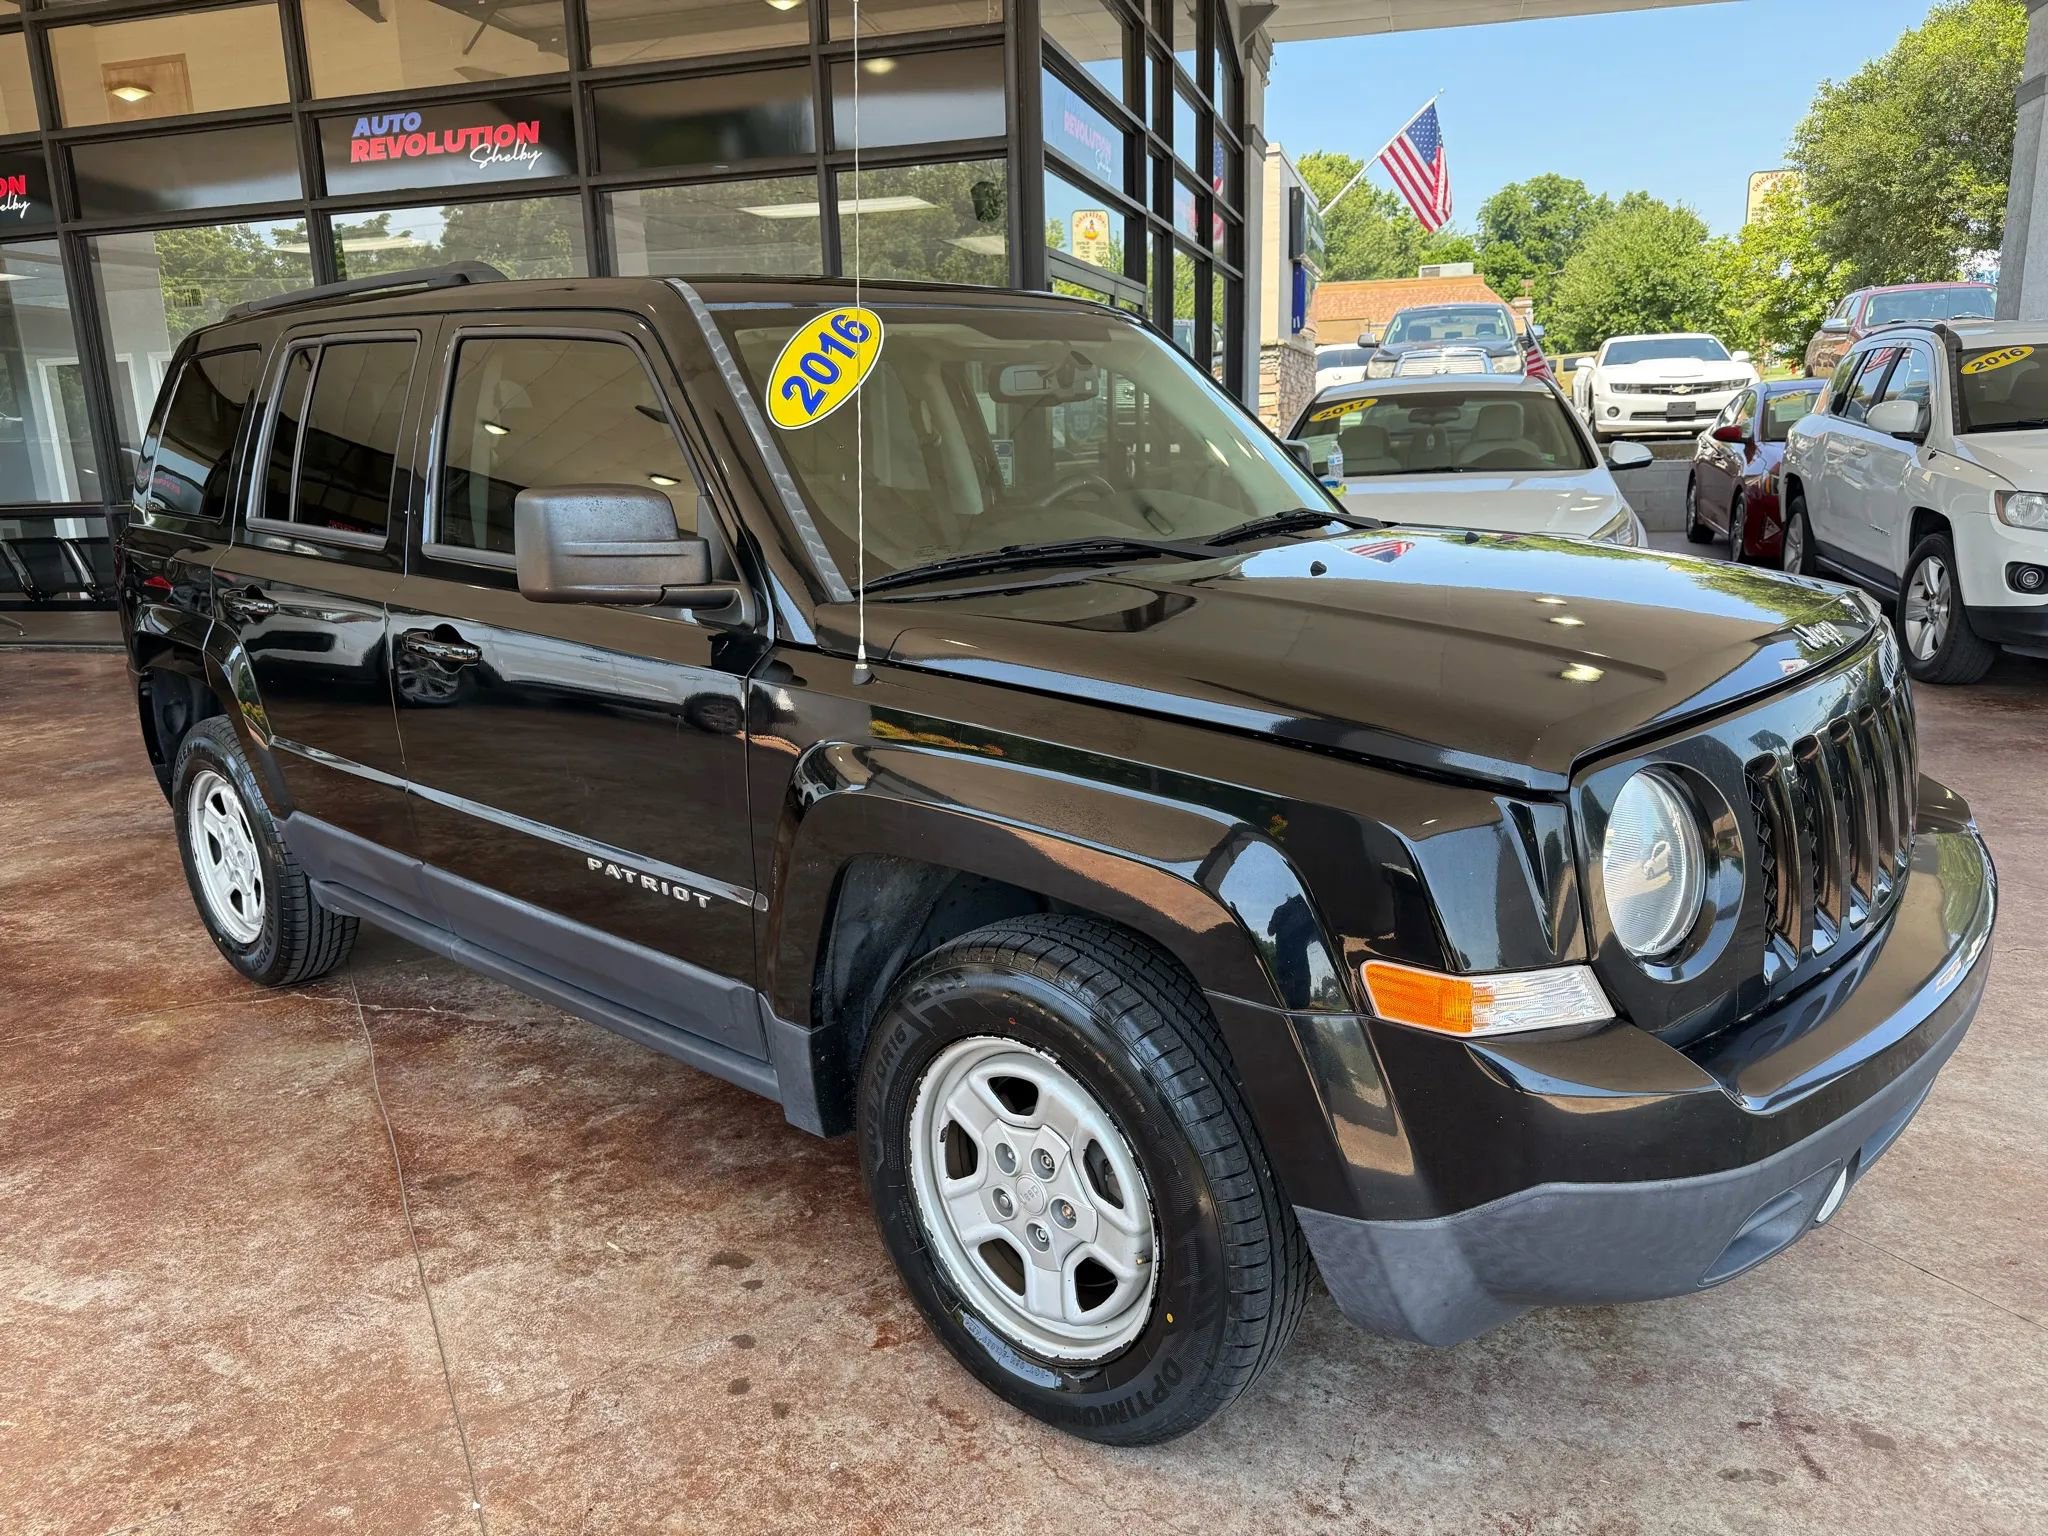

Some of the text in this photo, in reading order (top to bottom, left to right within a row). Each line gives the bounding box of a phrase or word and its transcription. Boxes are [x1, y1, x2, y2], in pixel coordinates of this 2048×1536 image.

[352, 112, 421, 137] AUTO
[351, 121, 539, 163] REVOLUTION
[470, 139, 542, 170] Shelby
[1751, 172, 1779, 192] CHICKEN
[781, 314, 872, 416] 2016
[1971, 349, 2024, 371] 2016
[1319, 400, 1368, 419] 2017
[587, 857, 712, 909] PATRIOT
